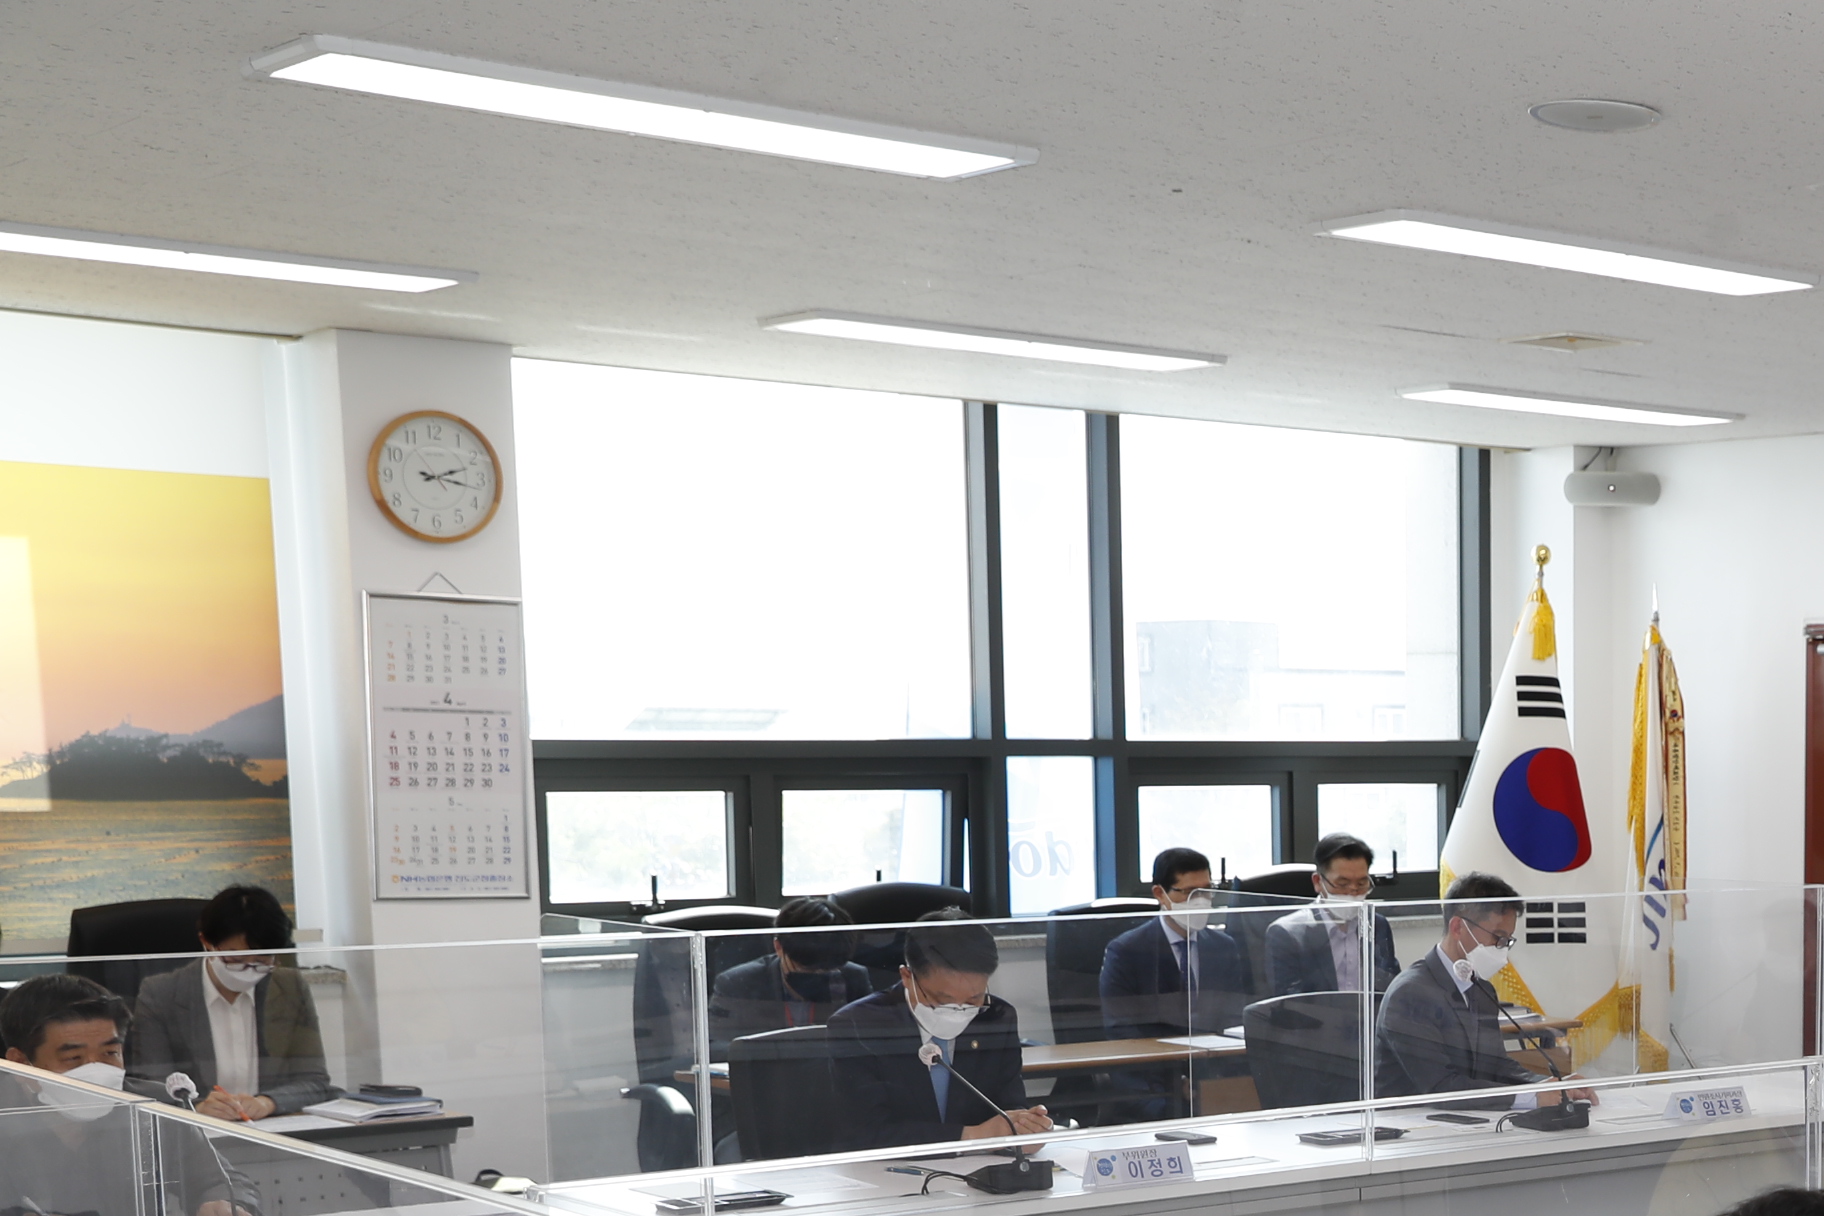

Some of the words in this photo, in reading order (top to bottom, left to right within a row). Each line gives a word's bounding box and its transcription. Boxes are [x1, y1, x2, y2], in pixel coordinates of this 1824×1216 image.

[405, 430, 416, 445] 11
[427, 425, 442, 440] 12
[456, 433, 460, 448] 1
[387, 447, 403, 463] 10
[469, 450, 477, 466] 2
[383, 468, 393, 483] 9
[476, 472, 485, 487] 3
[393, 493, 402, 508] 8
[470, 496, 478, 510] 4
[411, 508, 419, 523] 7
[432, 515, 441, 529] 6
[455, 509, 464, 524] 5
[443, 692, 452, 705] 4
[465, 717, 469, 726] 1
[483, 717, 488, 727] 2
[501, 718, 506, 728] 3
[390, 731, 396, 739] 4
[409, 731, 415, 740] 5
[428, 732, 434, 741] 6
[446, 731, 452, 741] 7
[465, 732, 471, 742] 8
[483, 733, 488, 742] 9
[498, 733, 509, 743] 10
[389, 746, 398, 755] 11
[407, 746, 417, 756] 12
[427, 747, 436, 756] 13
[445, 747, 454, 756] 14
[463, 747, 473, 757] 15
[481, 748, 491, 757] 16
[499, 748, 509, 758] 17
[389, 761, 399, 771] 18
[408, 762, 418, 771] 19
[426, 762, 438, 772] 20
[445, 762, 455, 772] 21
[463, 763, 474, 773] 22
[481, 763, 492, 773] 23
[499, 763, 510, 773] 24
[390, 777, 400, 786] 25
[409, 777, 419, 787] 26
[427, 777, 438, 787] 27
[445, 778, 456, 787] 28
[464, 778, 474, 787] 29
[482, 778, 492, 788] 30
[1702, 1098, 1744, 1116] 임진홍
[1122, 1149, 1157, 1160] 부위원장
[1128, 1156, 1183, 1178] 이정희
